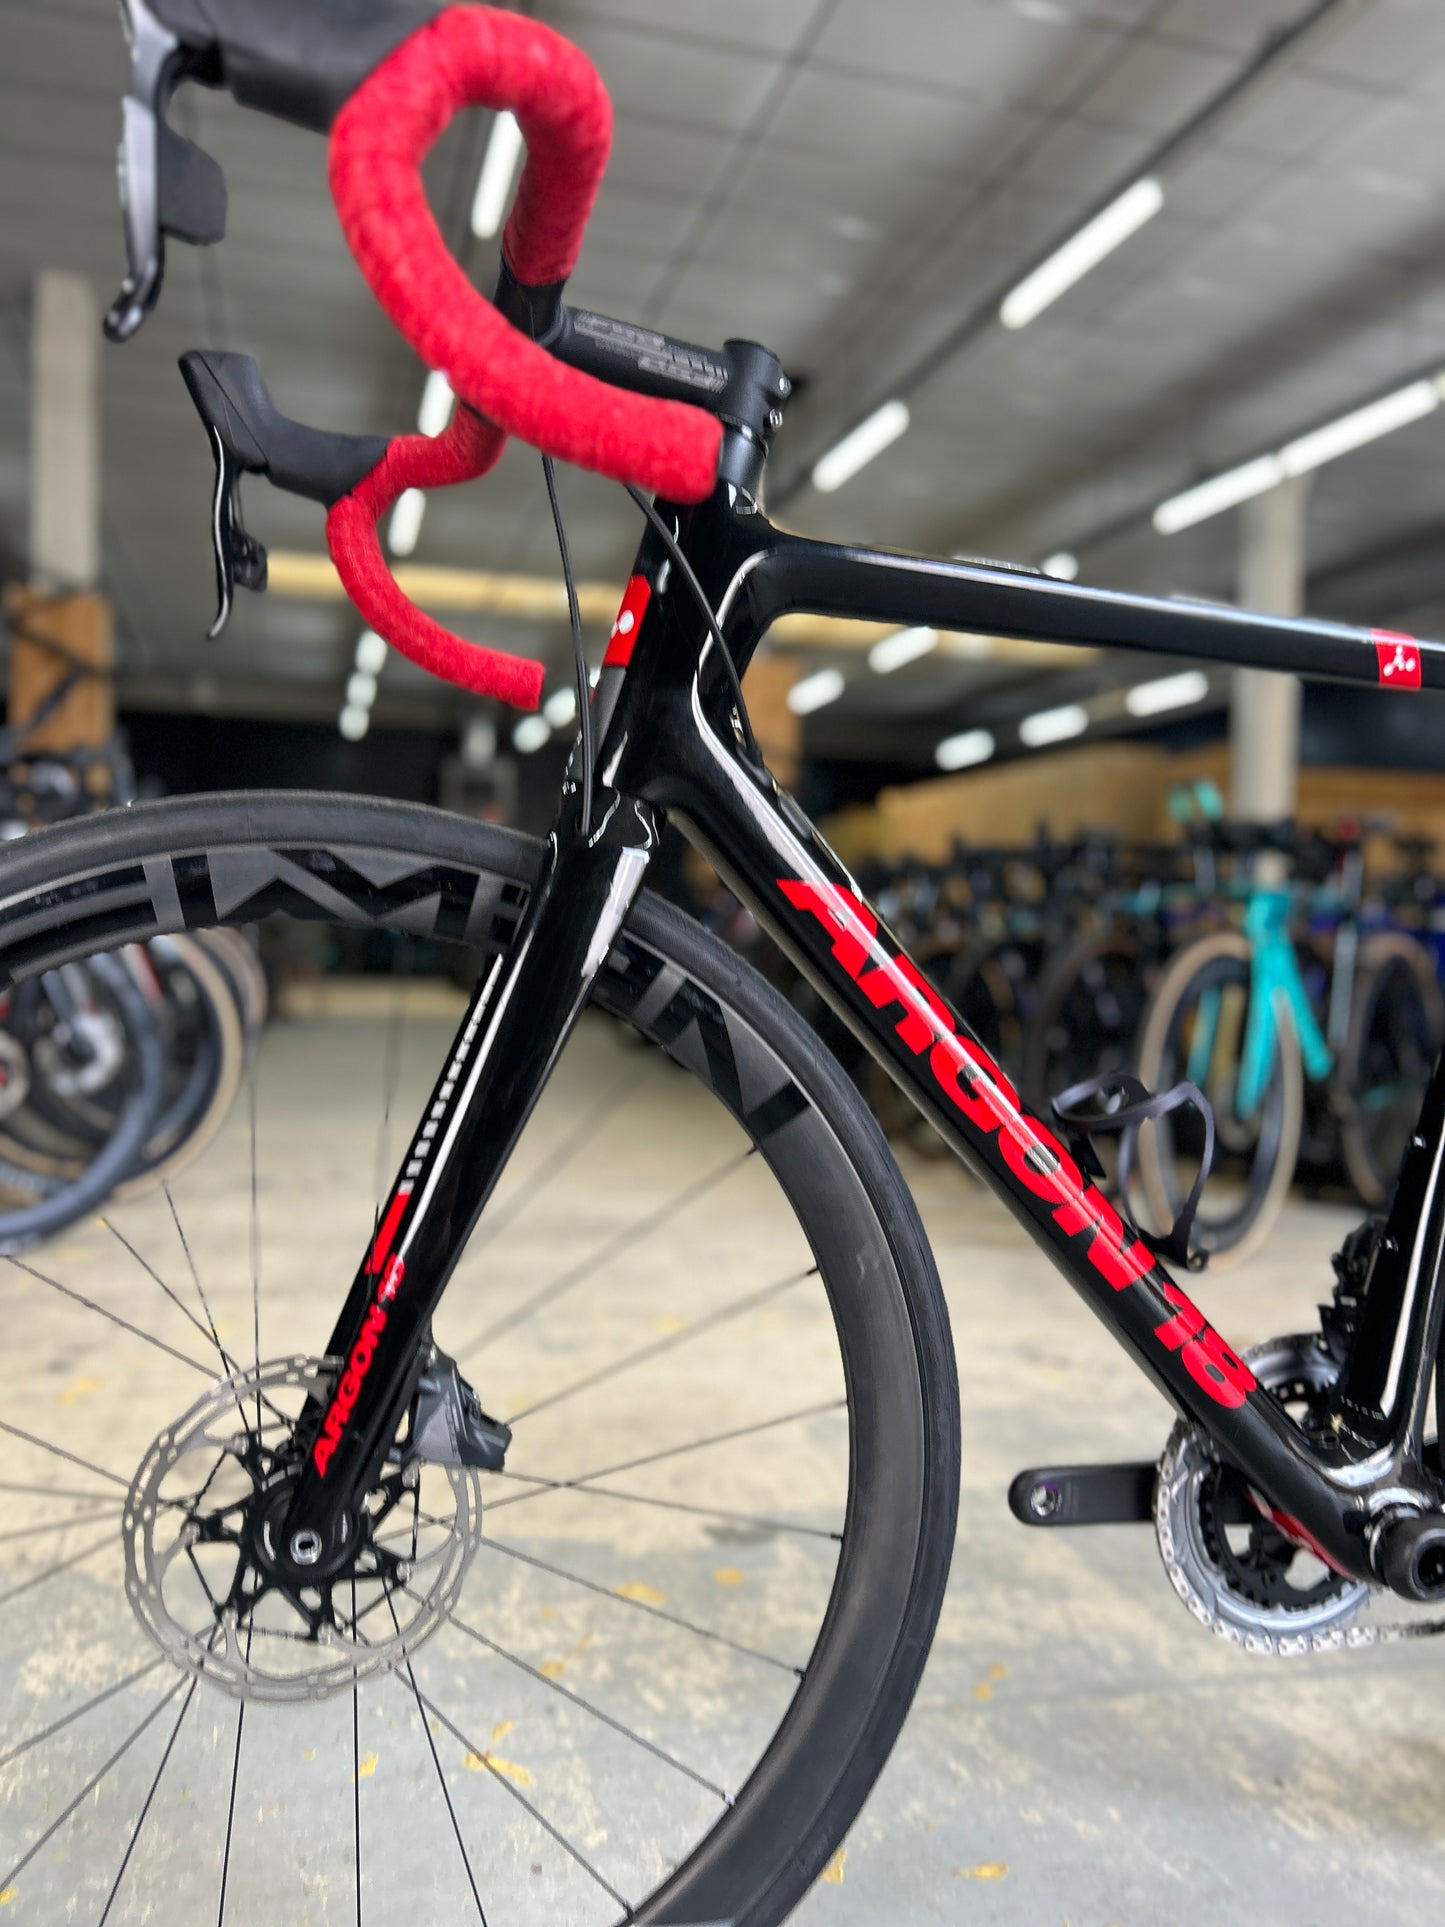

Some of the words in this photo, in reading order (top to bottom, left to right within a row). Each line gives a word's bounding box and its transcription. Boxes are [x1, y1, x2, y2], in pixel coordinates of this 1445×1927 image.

[777, 879, 1156, 1291] ARGON
[1154, 1282, 1258, 1409] 18
[314, 1303, 387, 1478] ARGON
[377, 1252, 405, 1303] 18
